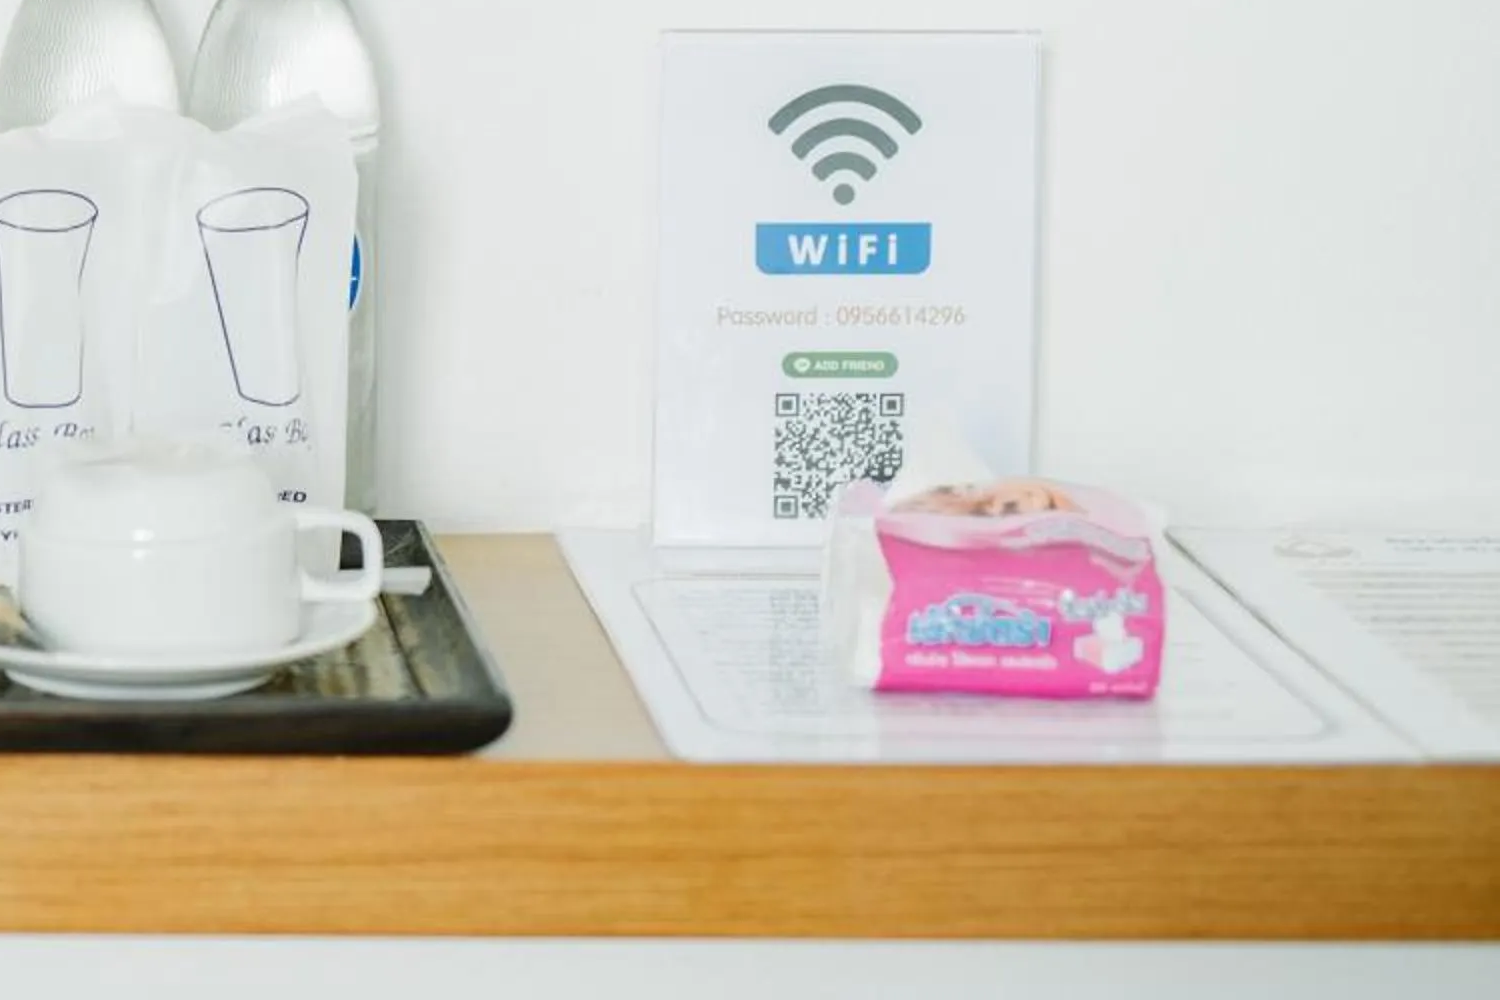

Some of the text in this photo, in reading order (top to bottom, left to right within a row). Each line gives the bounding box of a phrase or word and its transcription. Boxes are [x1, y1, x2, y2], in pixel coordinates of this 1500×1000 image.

[787, 232, 899, 266] WiFi
[716, 305, 819, 327] Password
[835, 305, 966, 326] 0956614296
[813, 360, 839, 371] ADD
